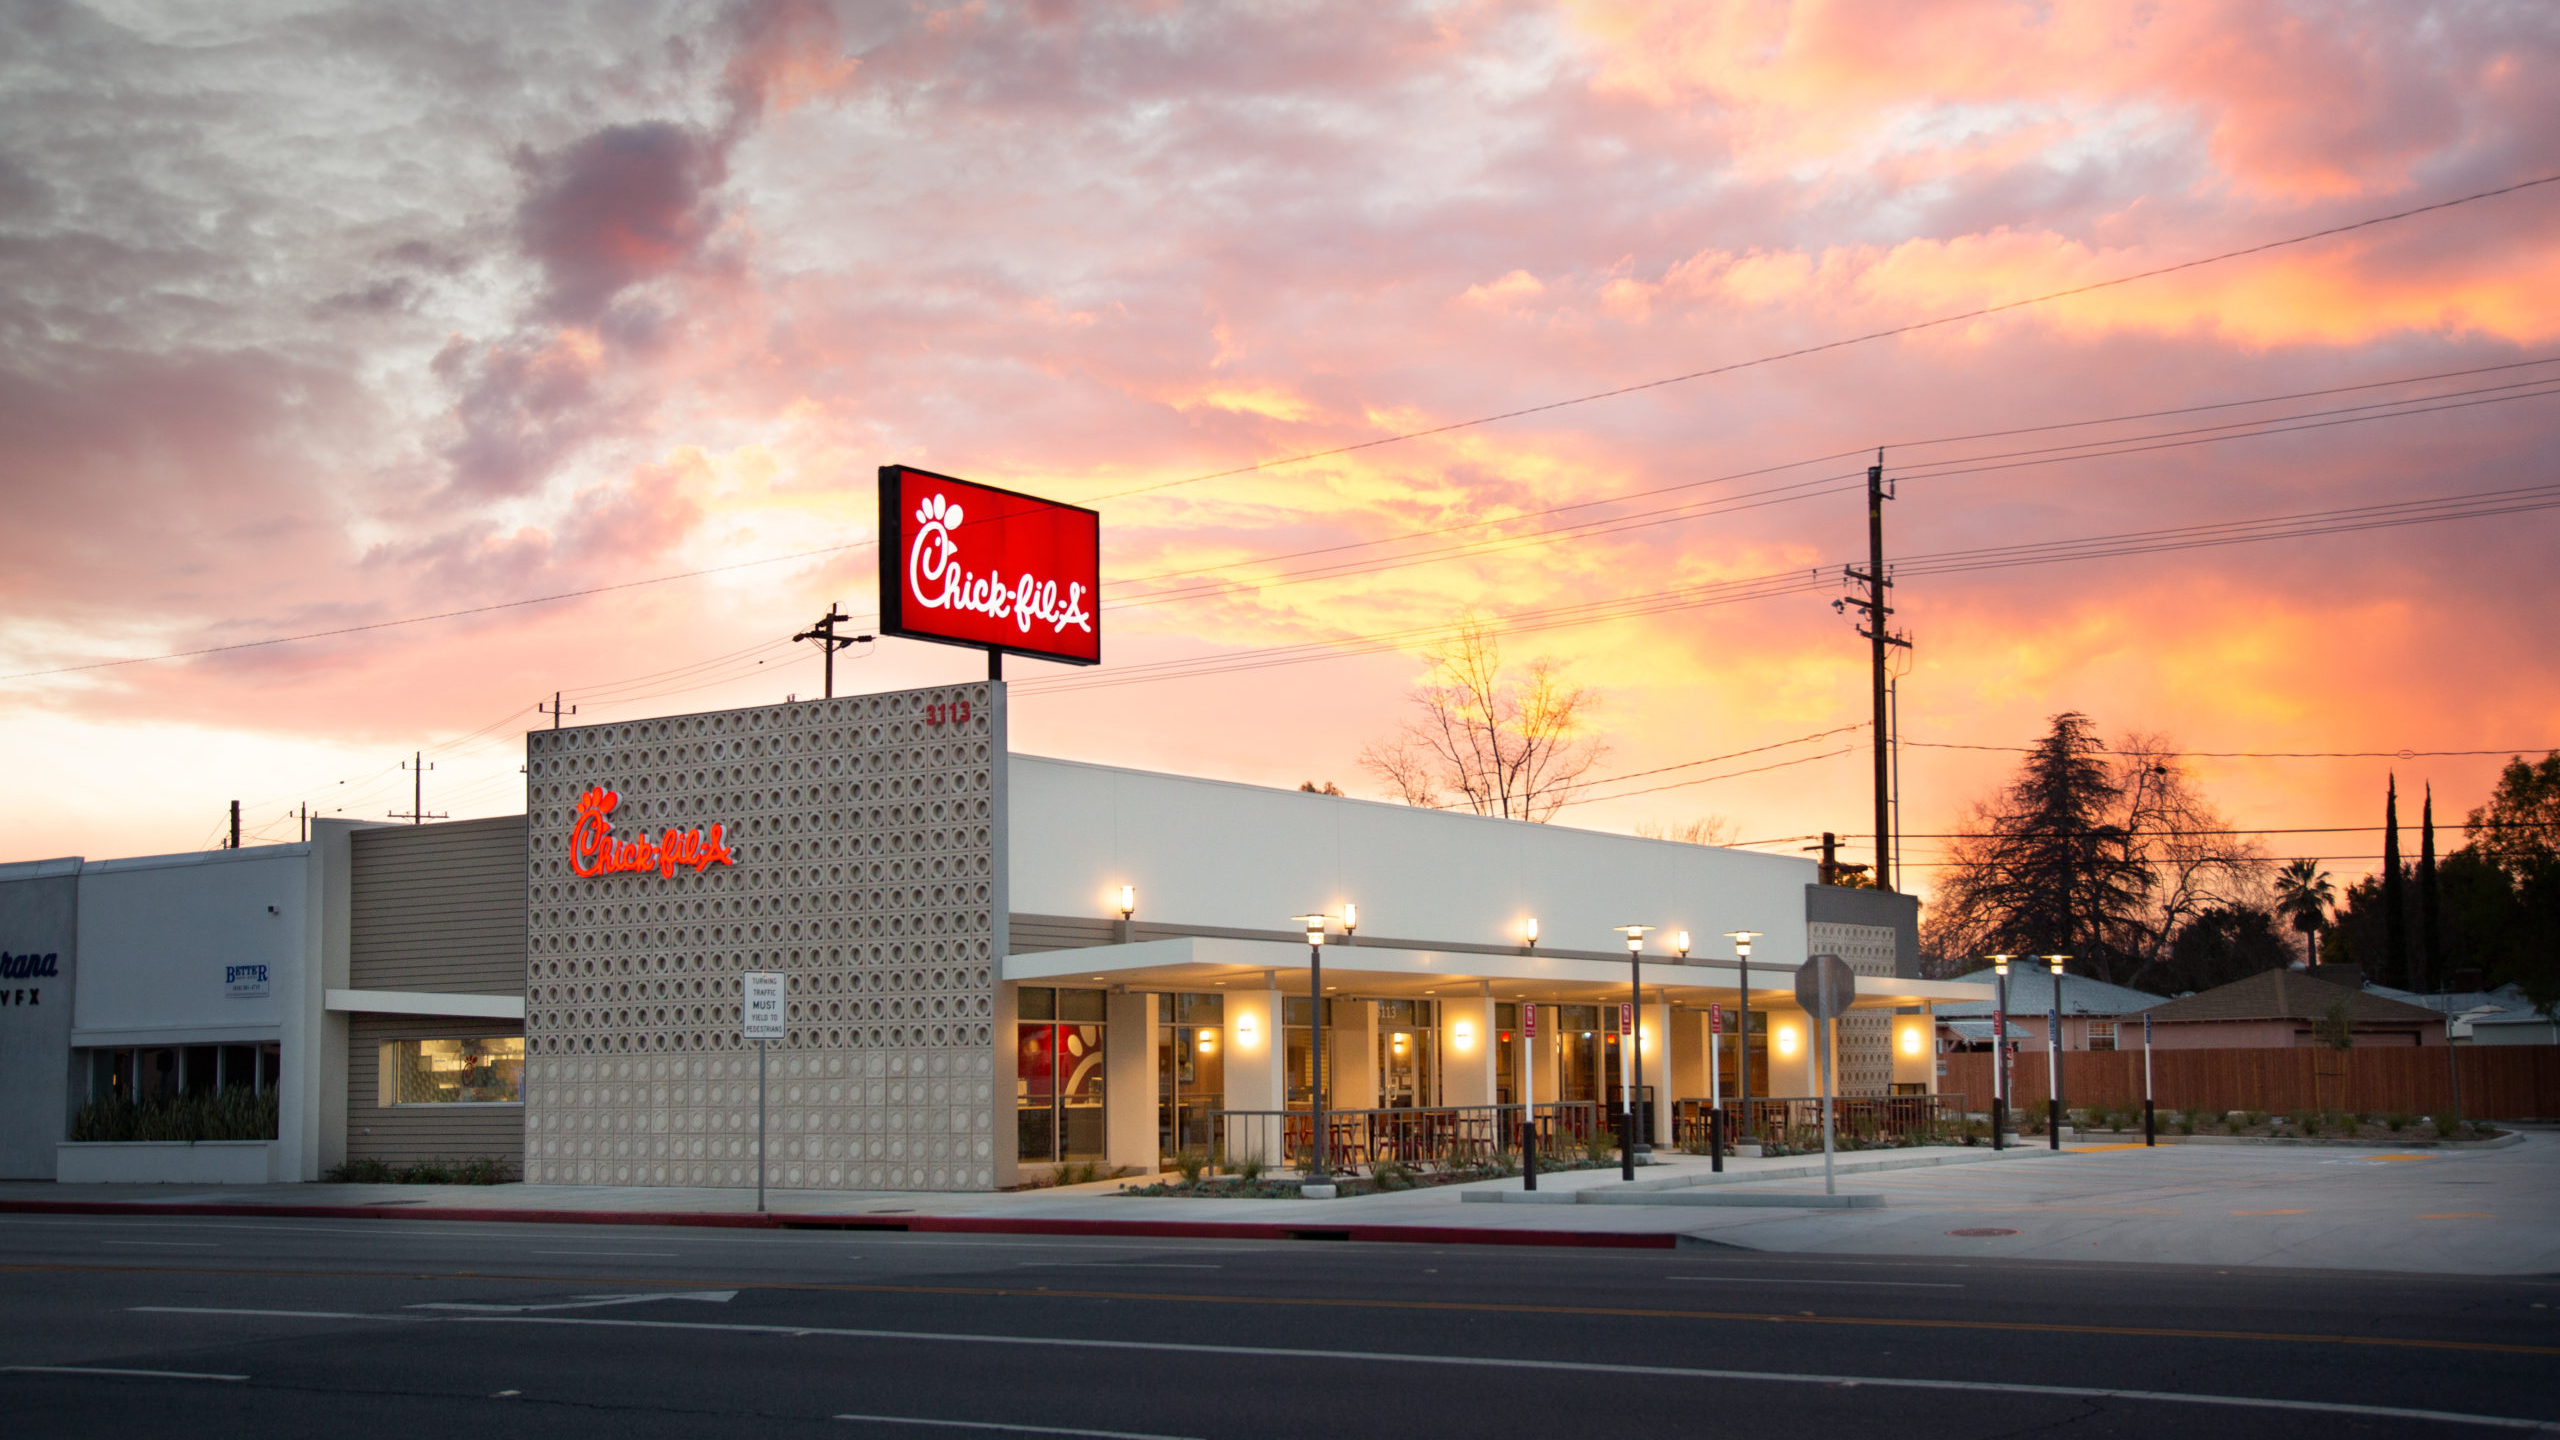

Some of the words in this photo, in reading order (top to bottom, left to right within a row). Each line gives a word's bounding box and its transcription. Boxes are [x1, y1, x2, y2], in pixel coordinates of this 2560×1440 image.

[909, 520, 1092, 633] Chick-fil-A
[926, 700, 971, 726] 3113
[570, 808, 734, 880] Chick-fil-A
[752, 977, 777, 985] TURNING
[753, 1001, 776, 1009] MUST
[746, 1025, 782, 1033] PEDESTRIANS
